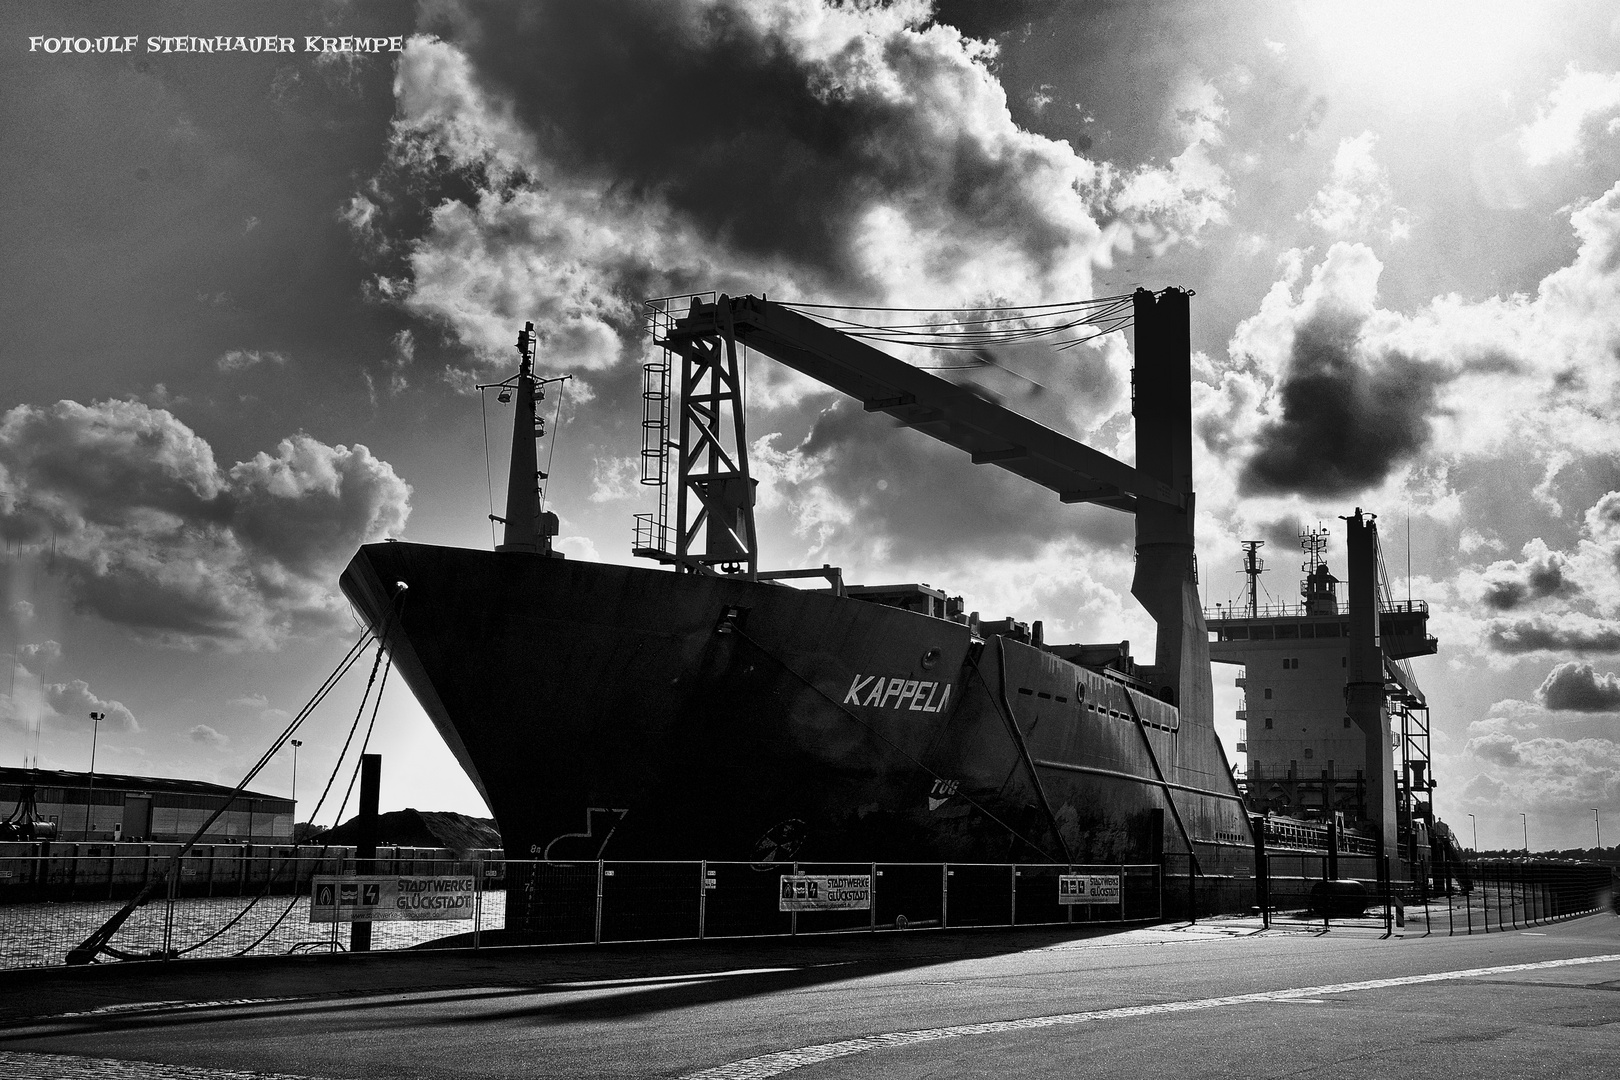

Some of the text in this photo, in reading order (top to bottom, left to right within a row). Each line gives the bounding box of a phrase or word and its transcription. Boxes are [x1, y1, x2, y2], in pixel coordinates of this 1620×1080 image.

[931, 779, 959, 795] TUG
[398, 879, 472, 892] STADTWERKE
[827, 878, 869, 888] STADTWERKE
[397, 893, 471, 909] GLÜCKSTADT
[827, 888, 869, 902] GLÜCKSTADT
